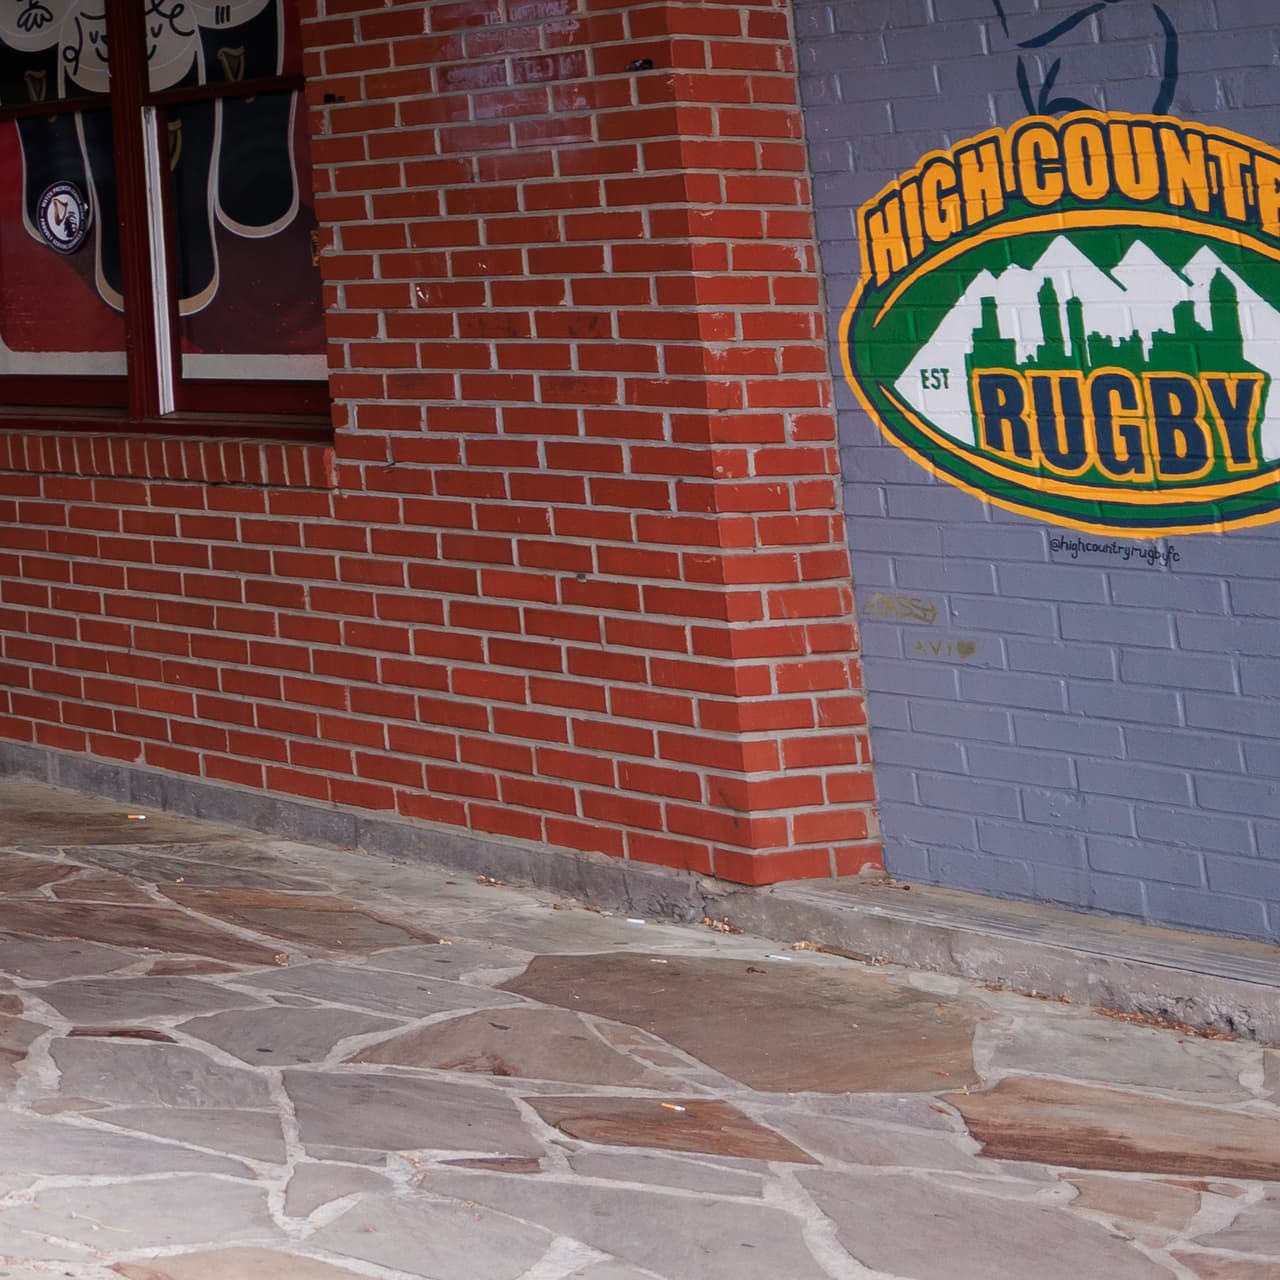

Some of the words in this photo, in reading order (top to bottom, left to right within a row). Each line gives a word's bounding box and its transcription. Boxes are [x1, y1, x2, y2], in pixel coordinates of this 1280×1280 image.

[864, 133, 1007, 289] HIGH
[919, 367, 950, 390] EST
[972, 367, 1271, 483] RUGBY
